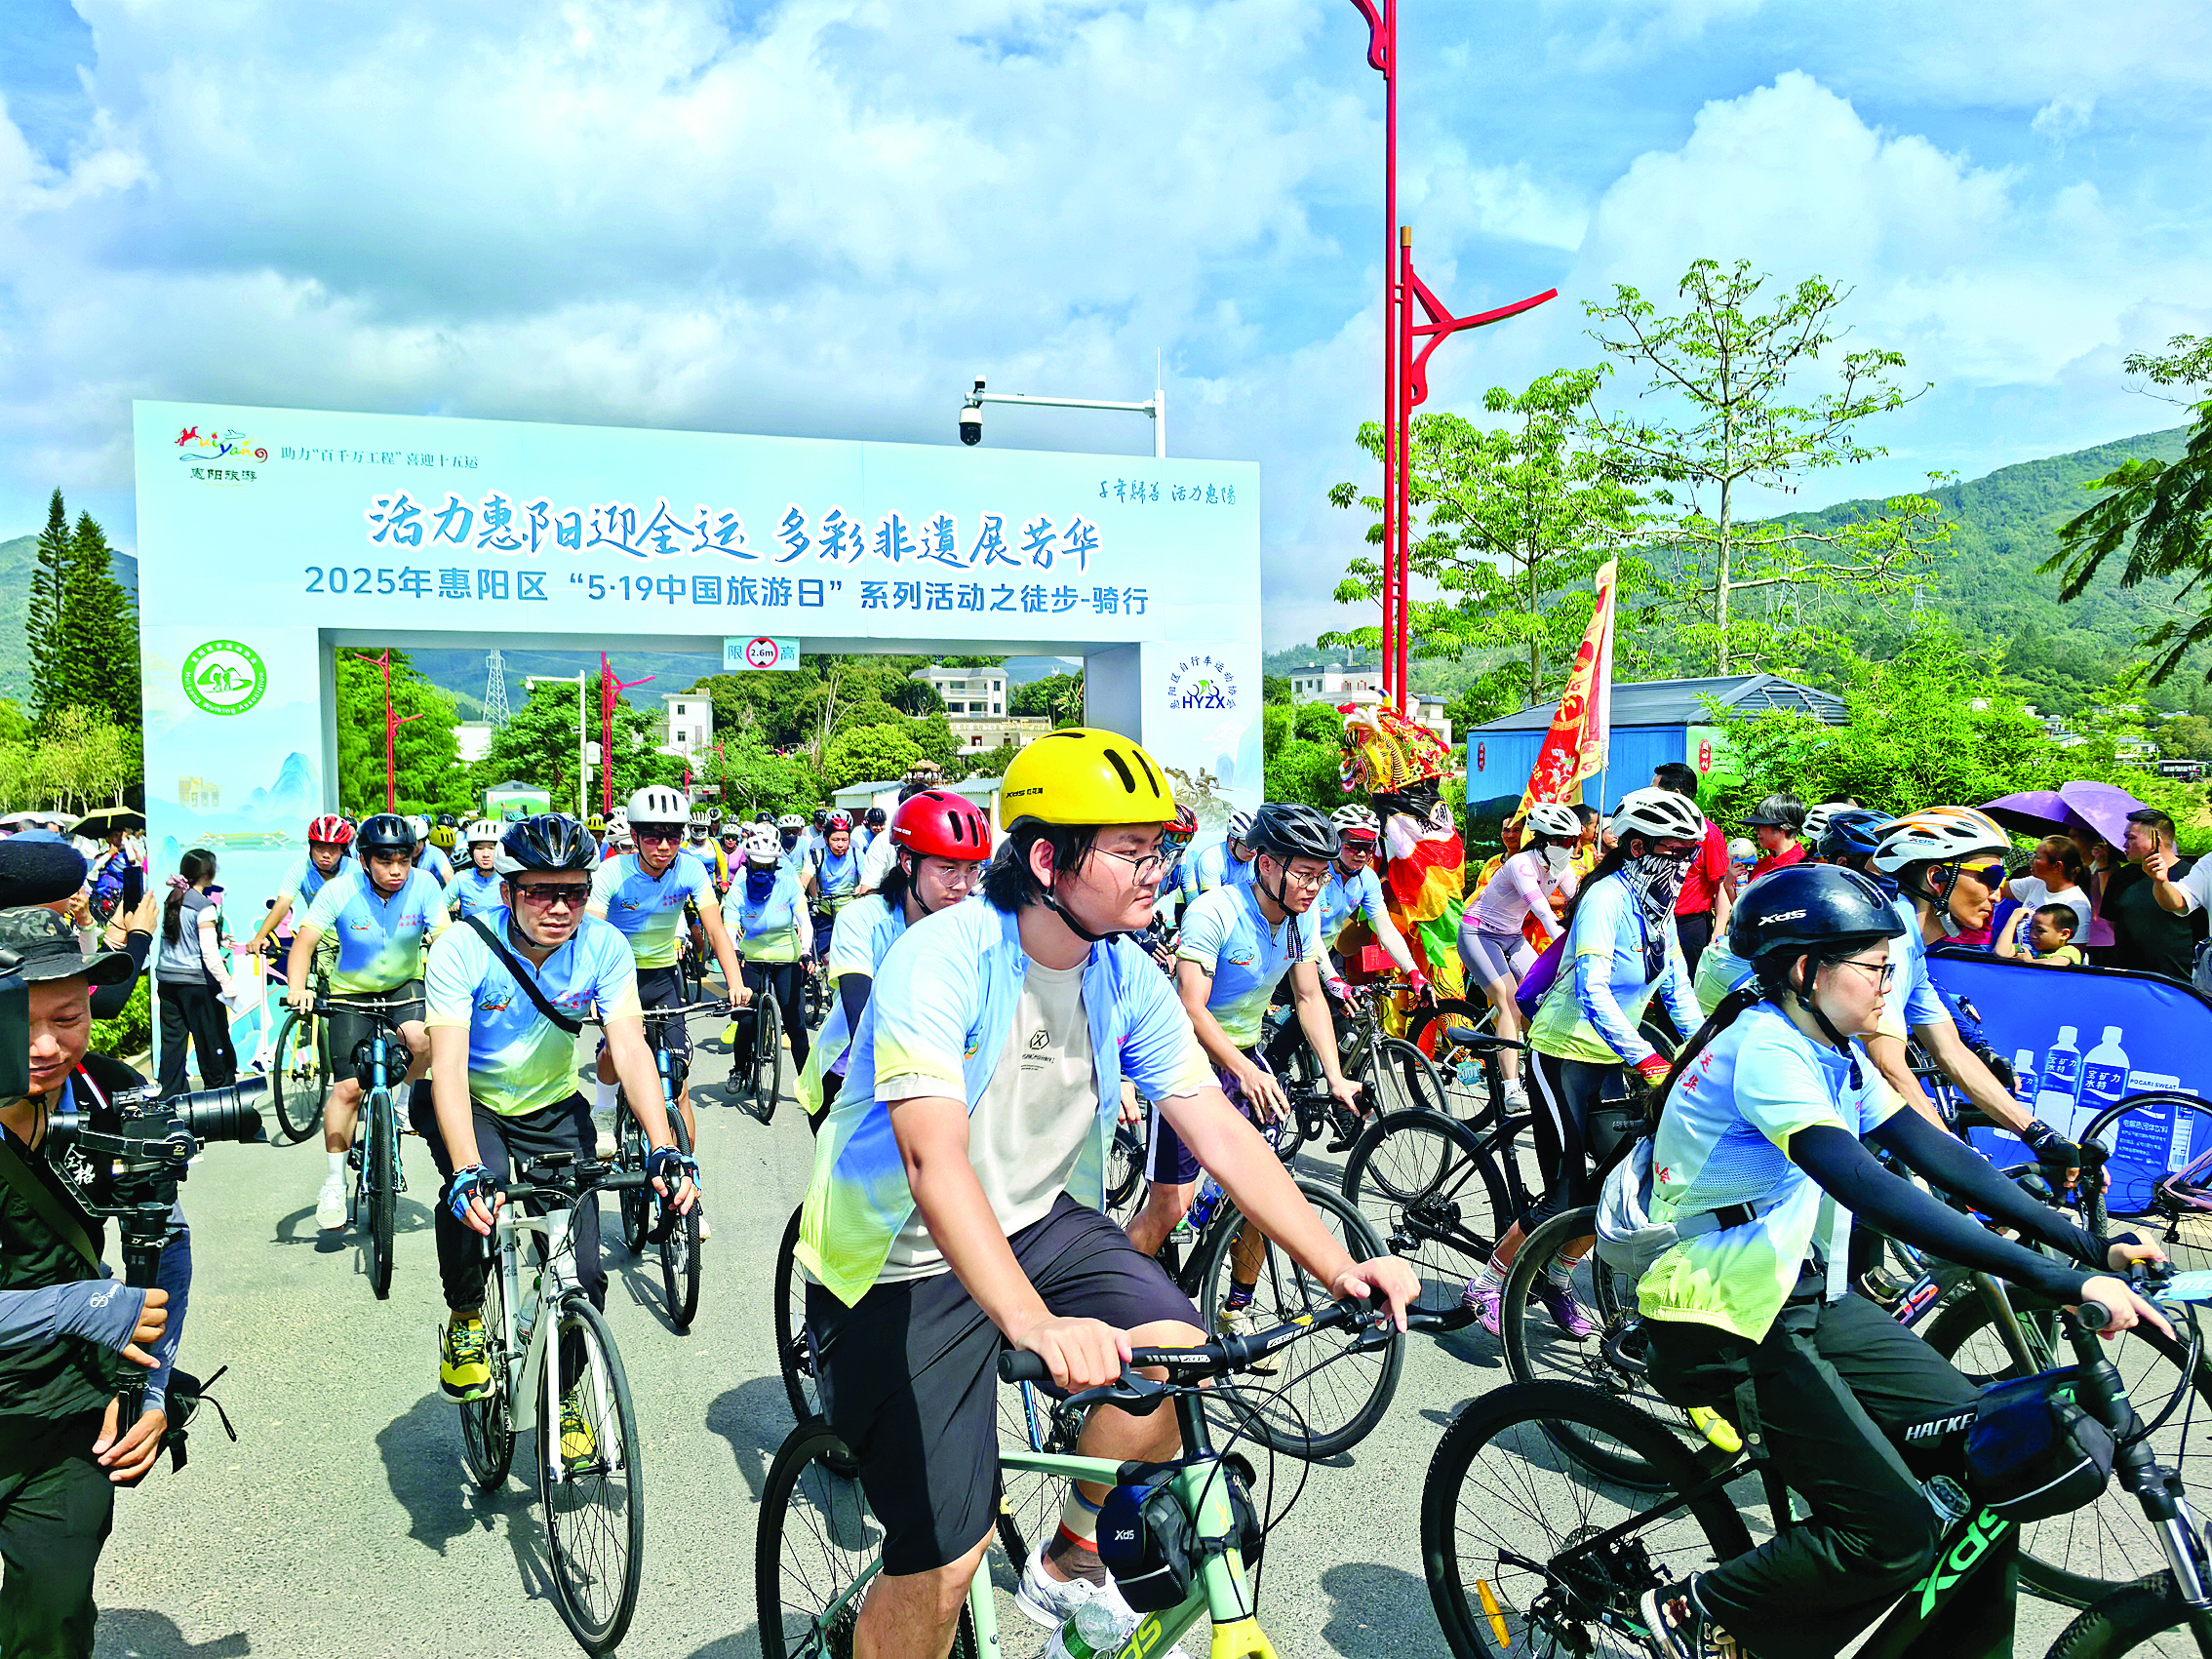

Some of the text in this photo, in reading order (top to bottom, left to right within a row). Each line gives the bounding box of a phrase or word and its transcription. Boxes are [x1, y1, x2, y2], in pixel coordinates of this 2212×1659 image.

[190, 467, 257, 483] 惠阳旅游
[367, 494, 761, 561] 活力惠阳迎全运
[303, 566, 549, 602] 2025年惠阳区
[859, 579, 1149, 616] 系列活动之徒步-骑行
[728, 645, 796, 661] 限 2.6m 高
[1182, 695, 1226, 709] HYZX
[2129, 1078, 2154, 1086] POCARI
[1905, 1412, 1979, 1441] HACKE
